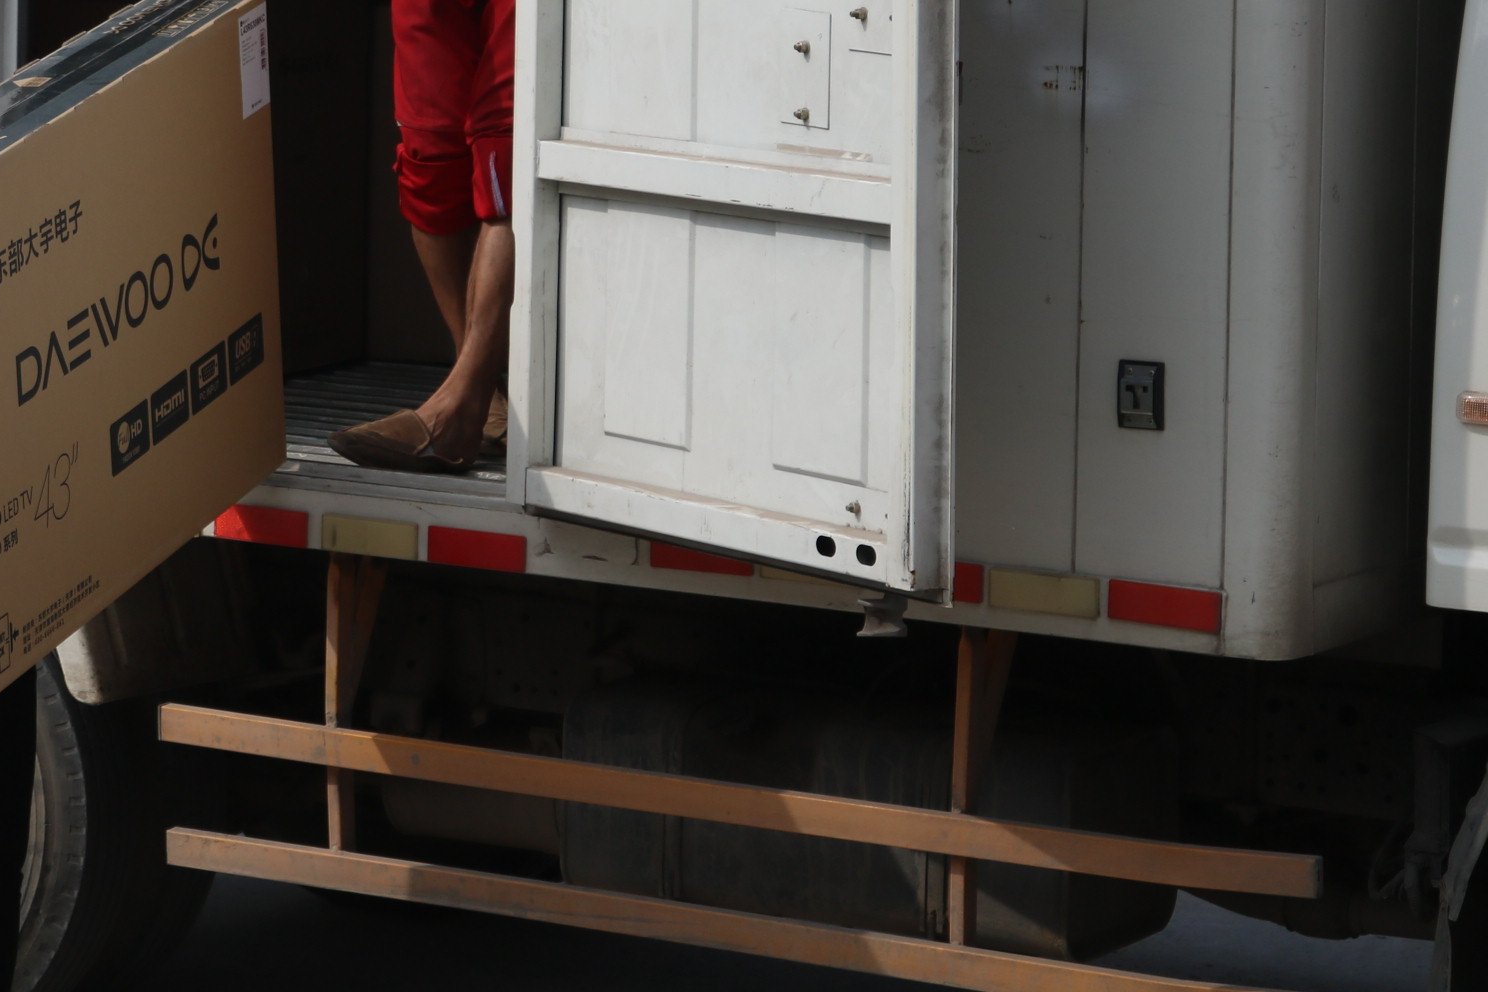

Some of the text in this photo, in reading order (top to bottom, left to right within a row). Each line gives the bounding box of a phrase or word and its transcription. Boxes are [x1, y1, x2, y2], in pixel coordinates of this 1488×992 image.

[15, 253, 174, 407] DAEWOO
[234, 331, 251, 359] USB
[130, 418, 143, 440] HD
[3, 496, 20, 523] LED
[20, 485, 33, 510] TV
[3, 527, 19, 553] 系列
